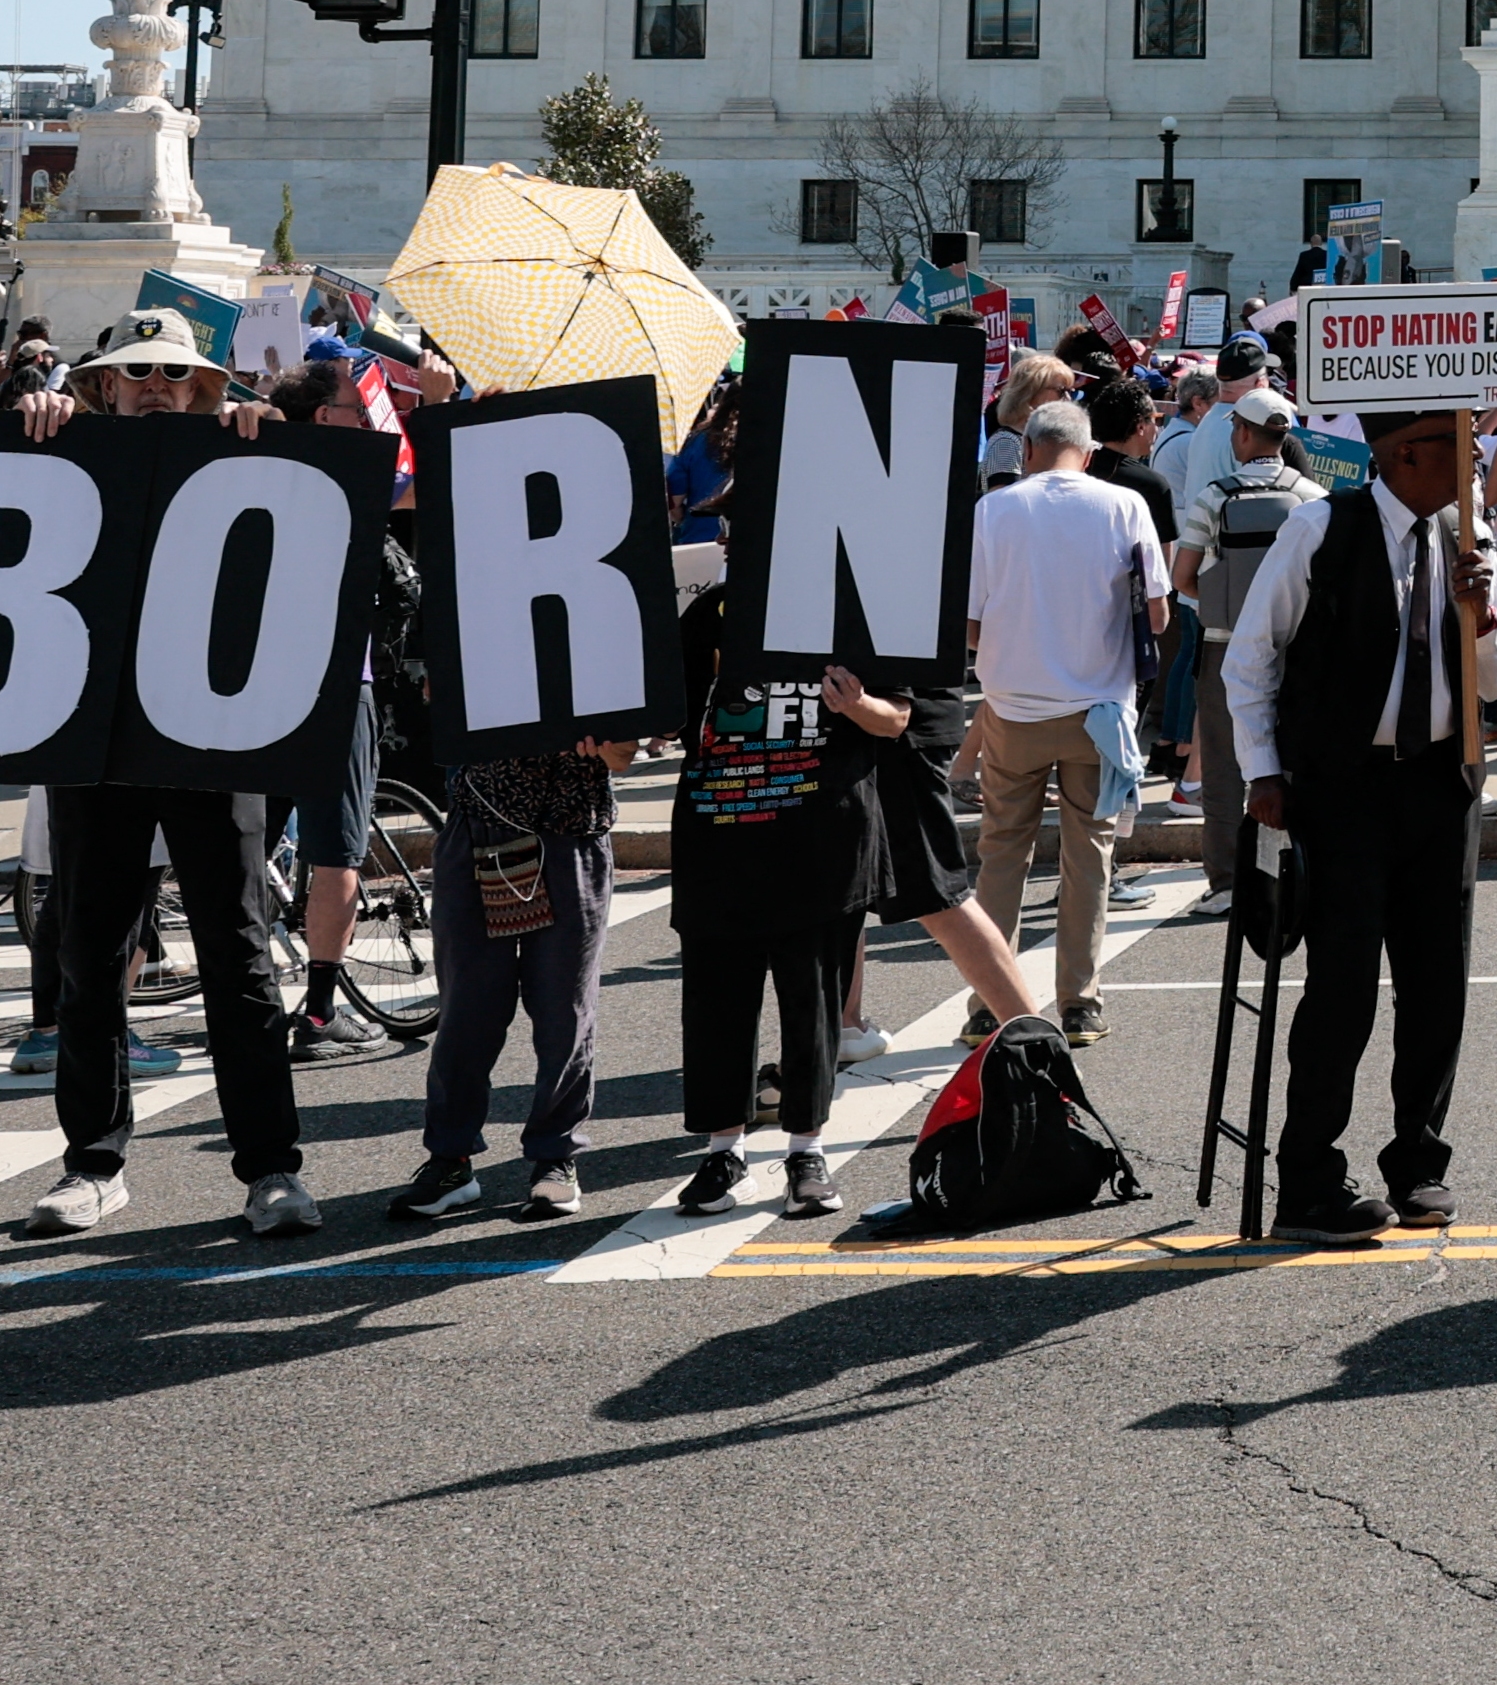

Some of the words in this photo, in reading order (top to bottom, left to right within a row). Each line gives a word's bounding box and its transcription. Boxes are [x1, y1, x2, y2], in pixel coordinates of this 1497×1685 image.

[985, 311, 1006, 338] TH
[1322, 314, 1384, 349] STOP
[1391, 312, 1477, 347] HATING
[1322, 354, 1418, 382] BECAUSE
[1425, 352, 1465, 378] YOU
[743, 741, 764, 751] SOCIAL
[766, 739, 795, 749] SECURITY
[723, 767, 744, 776] PUBLIC
[744, 765, 765, 775] LANDS
[770, 774, 804, 785] CONSUMER
[747, 788, 766, 798] CLEAN
[766, 786, 789, 796] ENERGY
[793, 781, 818, 794] SCHOOLS
[722, 803, 736, 812] FREE
[736, 802, 756, 811] SPEECH
[129, 1048, 151, 1060] OKA
